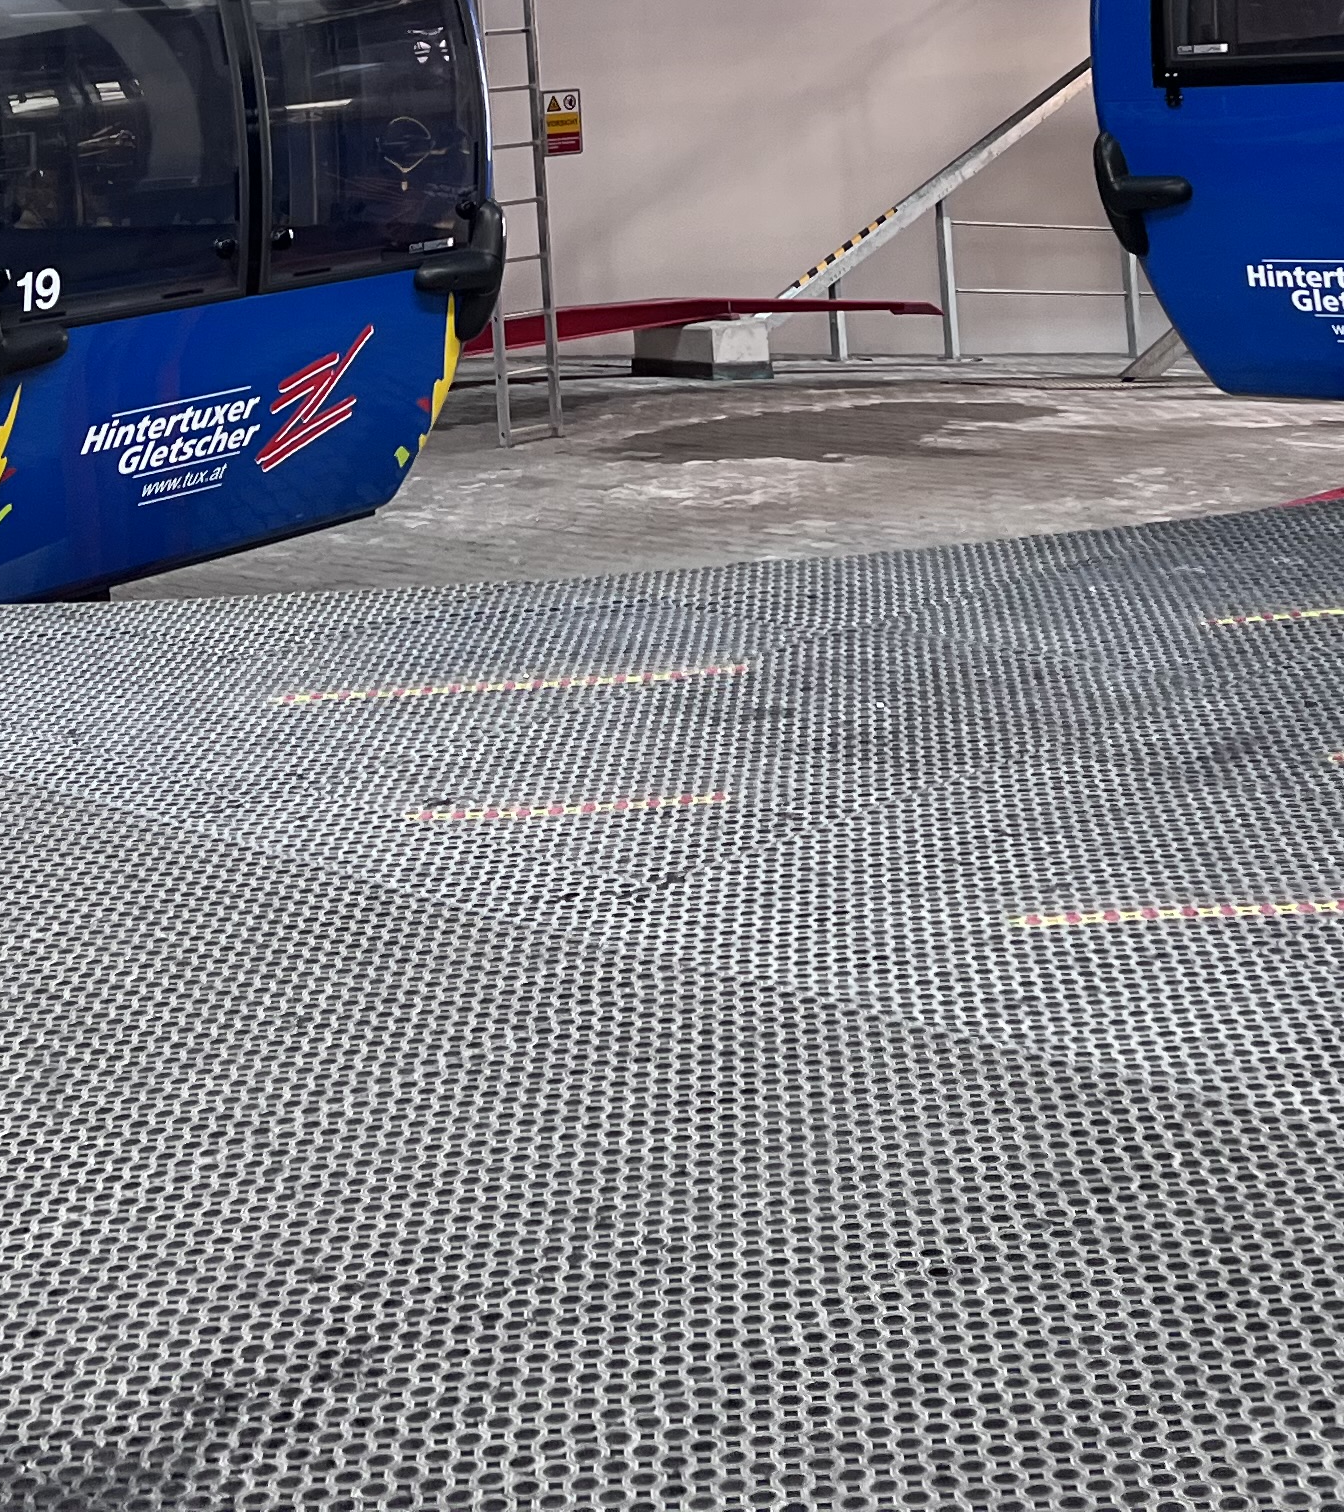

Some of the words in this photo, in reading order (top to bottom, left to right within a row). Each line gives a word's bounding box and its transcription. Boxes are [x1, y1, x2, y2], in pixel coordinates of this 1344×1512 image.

[16, 267, 61, 312] 19
[80, 396, 261, 455] Hintertuxer
[118, 424, 261, 475] Gletscher
[140, 463, 228, 497] www.tux.at
